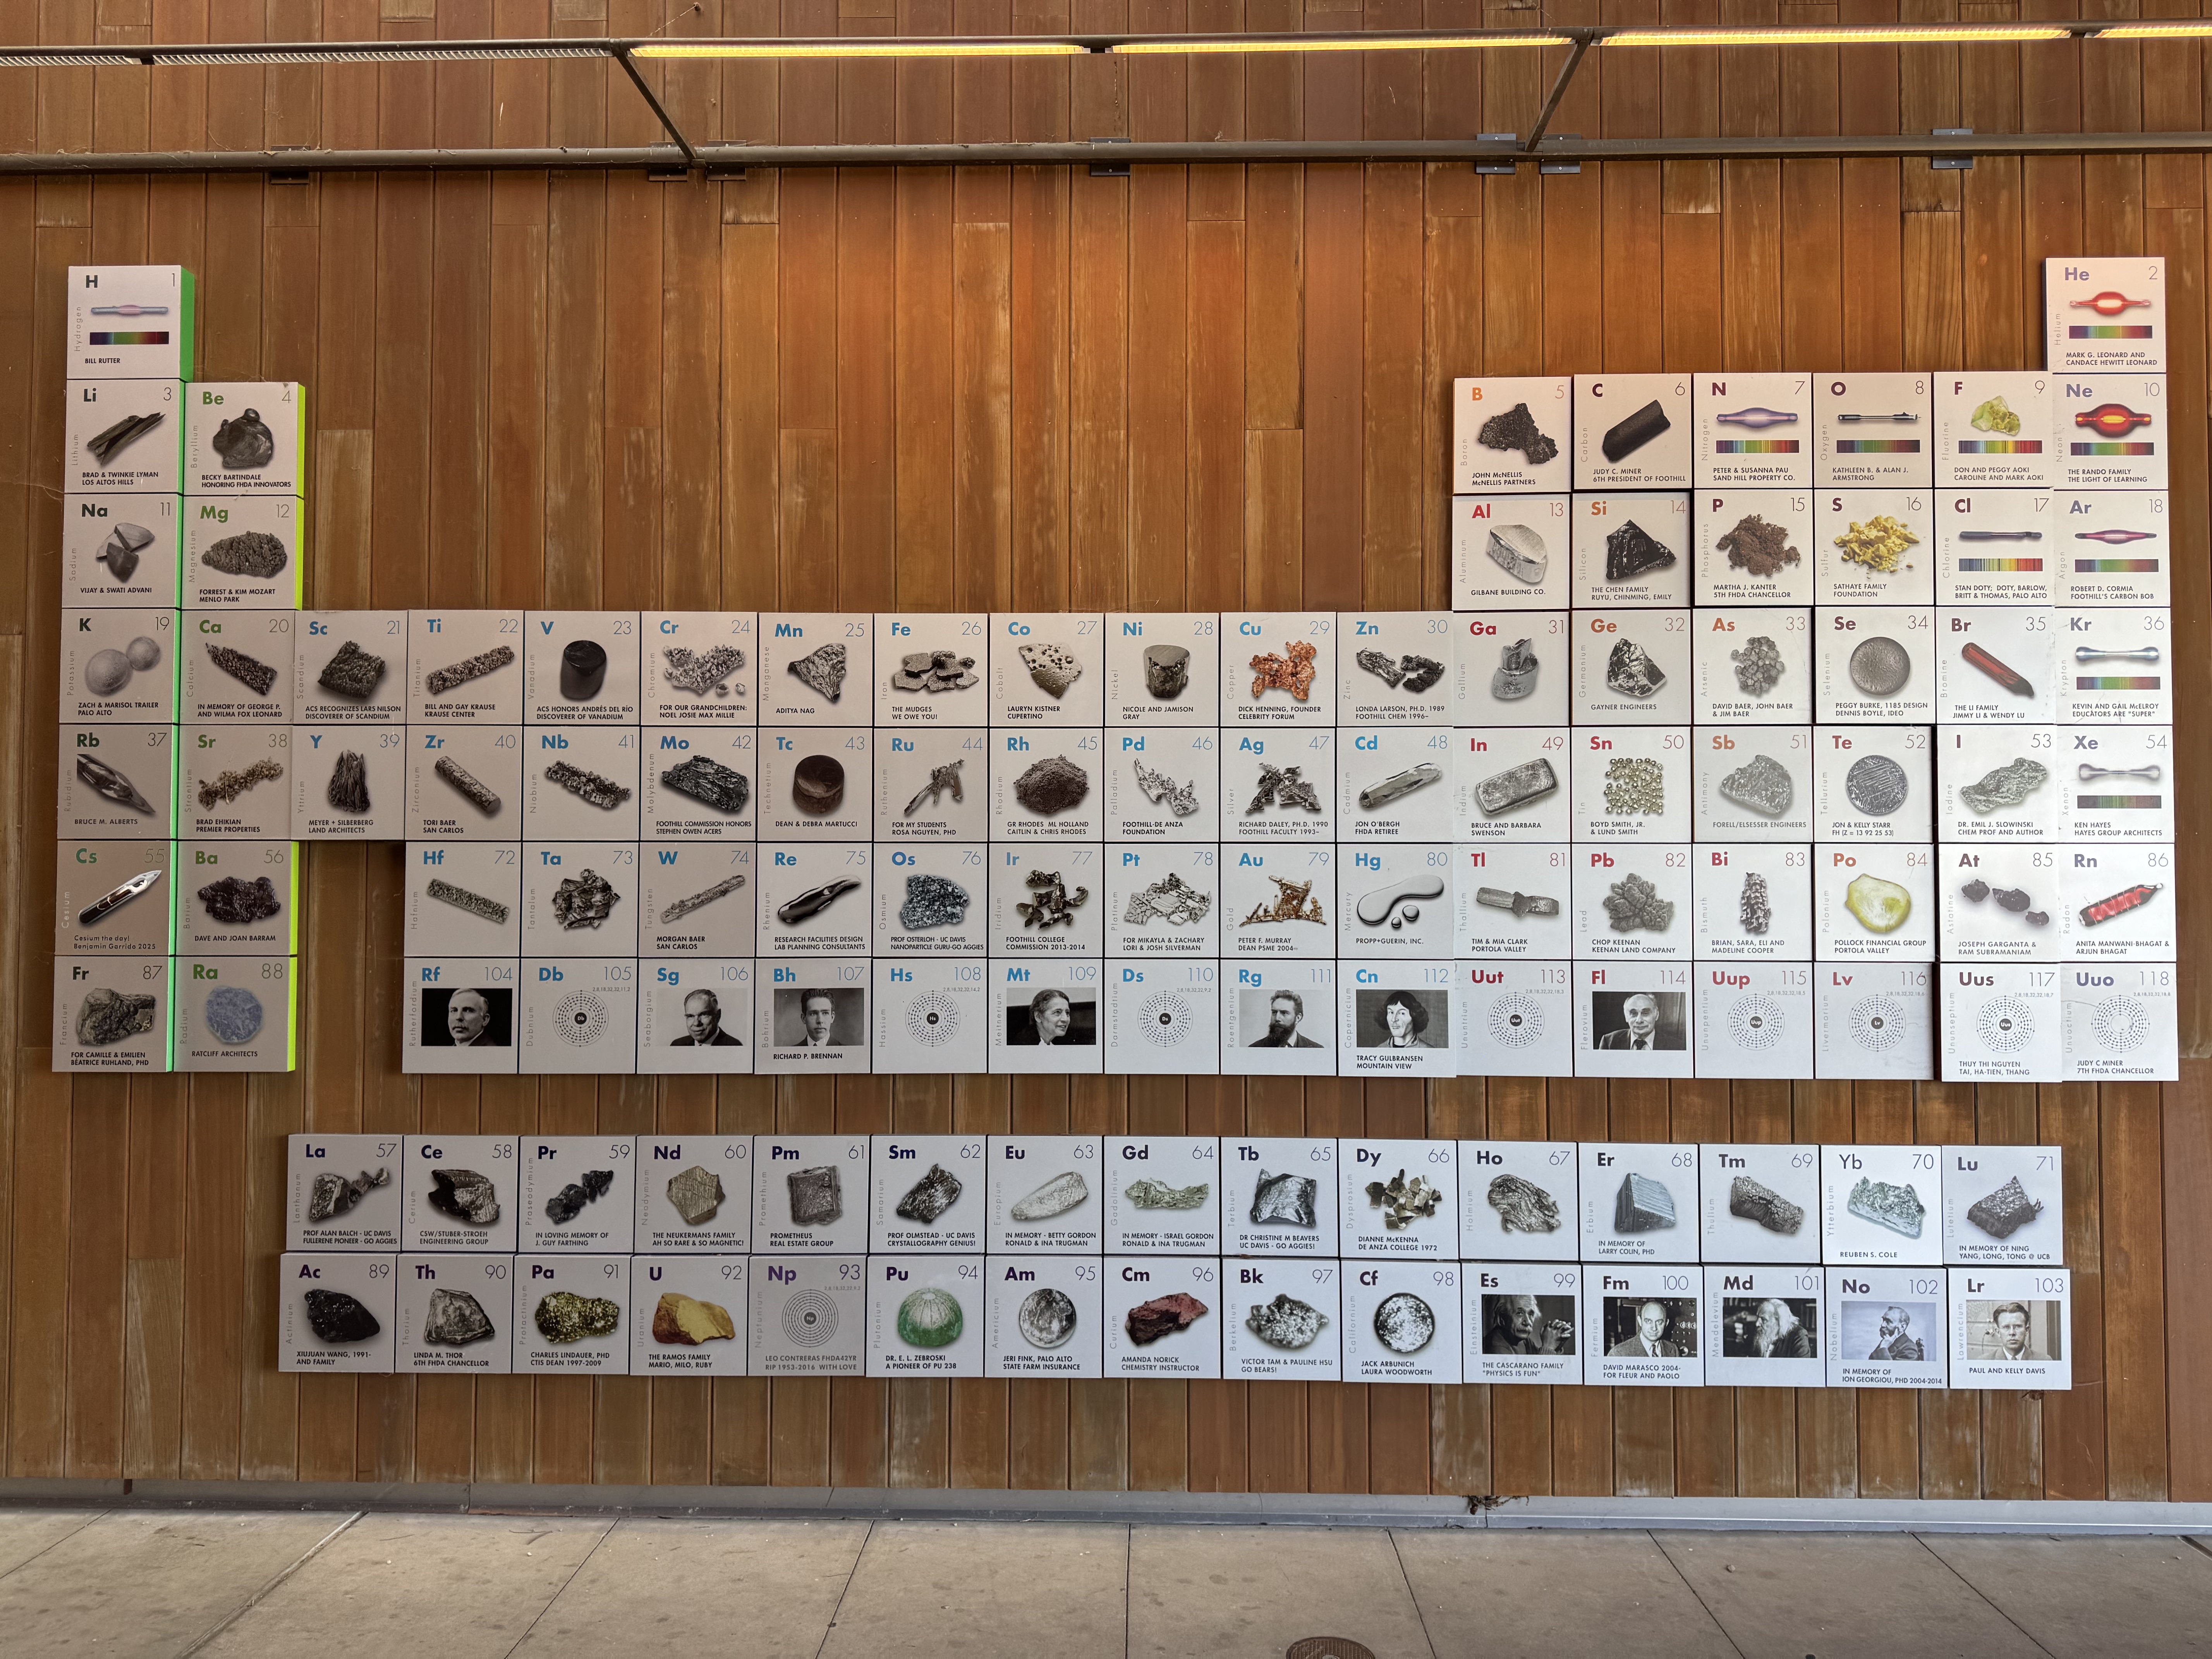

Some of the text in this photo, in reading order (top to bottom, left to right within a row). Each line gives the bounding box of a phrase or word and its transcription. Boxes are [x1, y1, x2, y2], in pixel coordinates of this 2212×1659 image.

[171, 273, 175, 287] 1
[2065, 267, 2089, 280] He
[2148, 266, 2158, 280] 2
[86, 275, 98, 288] H
[74, 307, 83, 352] Hydrogen
[203, 392, 224, 405] Be
[281, 390, 292, 404] 4
[1472, 387, 1483, 401] B
[1554, 385, 1565, 400] 5
[190, 425, 199, 468] Beryllium
[1472, 503, 1490, 518] Al
[1549, 502, 1563, 517] 13
[1832, 498, 1842, 512] S
[1906, 496, 1922, 511] 16
[1820, 550, 1829, 577] Sulfur
[1008, 622, 1030, 635] Co
[1077, 621, 1097, 635] 27
[77, 732, 99, 747] Rb
[148, 732, 167, 747] 37
[1123, 736, 1144, 751] Pd
[1192, 736, 1212, 750] 46
[1355, 735, 1377, 750] Cd
[1427, 735, 1448, 749] 48
[1712, 735, 1735, 750] Sb
[1790, 735, 1806, 749] 51
[2074, 736, 2098, 749] Xe
[2146, 734, 2167, 749] 54
[1701, 772, 1710, 815] Antimony
[76, 848, 96, 863] Cs
[144, 848, 165, 863] 55
[658, 852, 678, 864] W
[731, 850, 749, 864] 74
[62, 891, 70, 928] Cesium
[645, 889, 654, 930] Tungsten
[193, 964, 218, 979] Ra
[261, 963, 283, 979] 88
[539, 967, 563, 981] Db
[604, 966, 631, 981] 105
[774, 967, 795, 982] Bh
[837, 967, 865, 981] 107
[1592, 970, 1605, 984] Fl
[1660, 970, 1686, 985] 114
[1960, 972, 1994, 986] Uus
[2029, 972, 2055, 987] 117
[179, 1008, 188, 1044] Radium
[1580, 1005, 1588, 1050] Flerovium
[1948, 993, 1957, 1054] Ununseptium
[421, 1145, 442, 1159] Ce
[492, 1144, 513, 1159] 58
[1839, 1154, 1862, 1170] Yb
[1912, 1154, 1934, 1170] 70
[1826, 1185, 1834, 1237] Ytterbium
[1122, 1267, 1149, 1281] Cm
[1192, 1267, 1214, 1282] 96
[1968, 1279, 1984, 1292] Lr
[2035, 1278, 2064, 1293] 103
